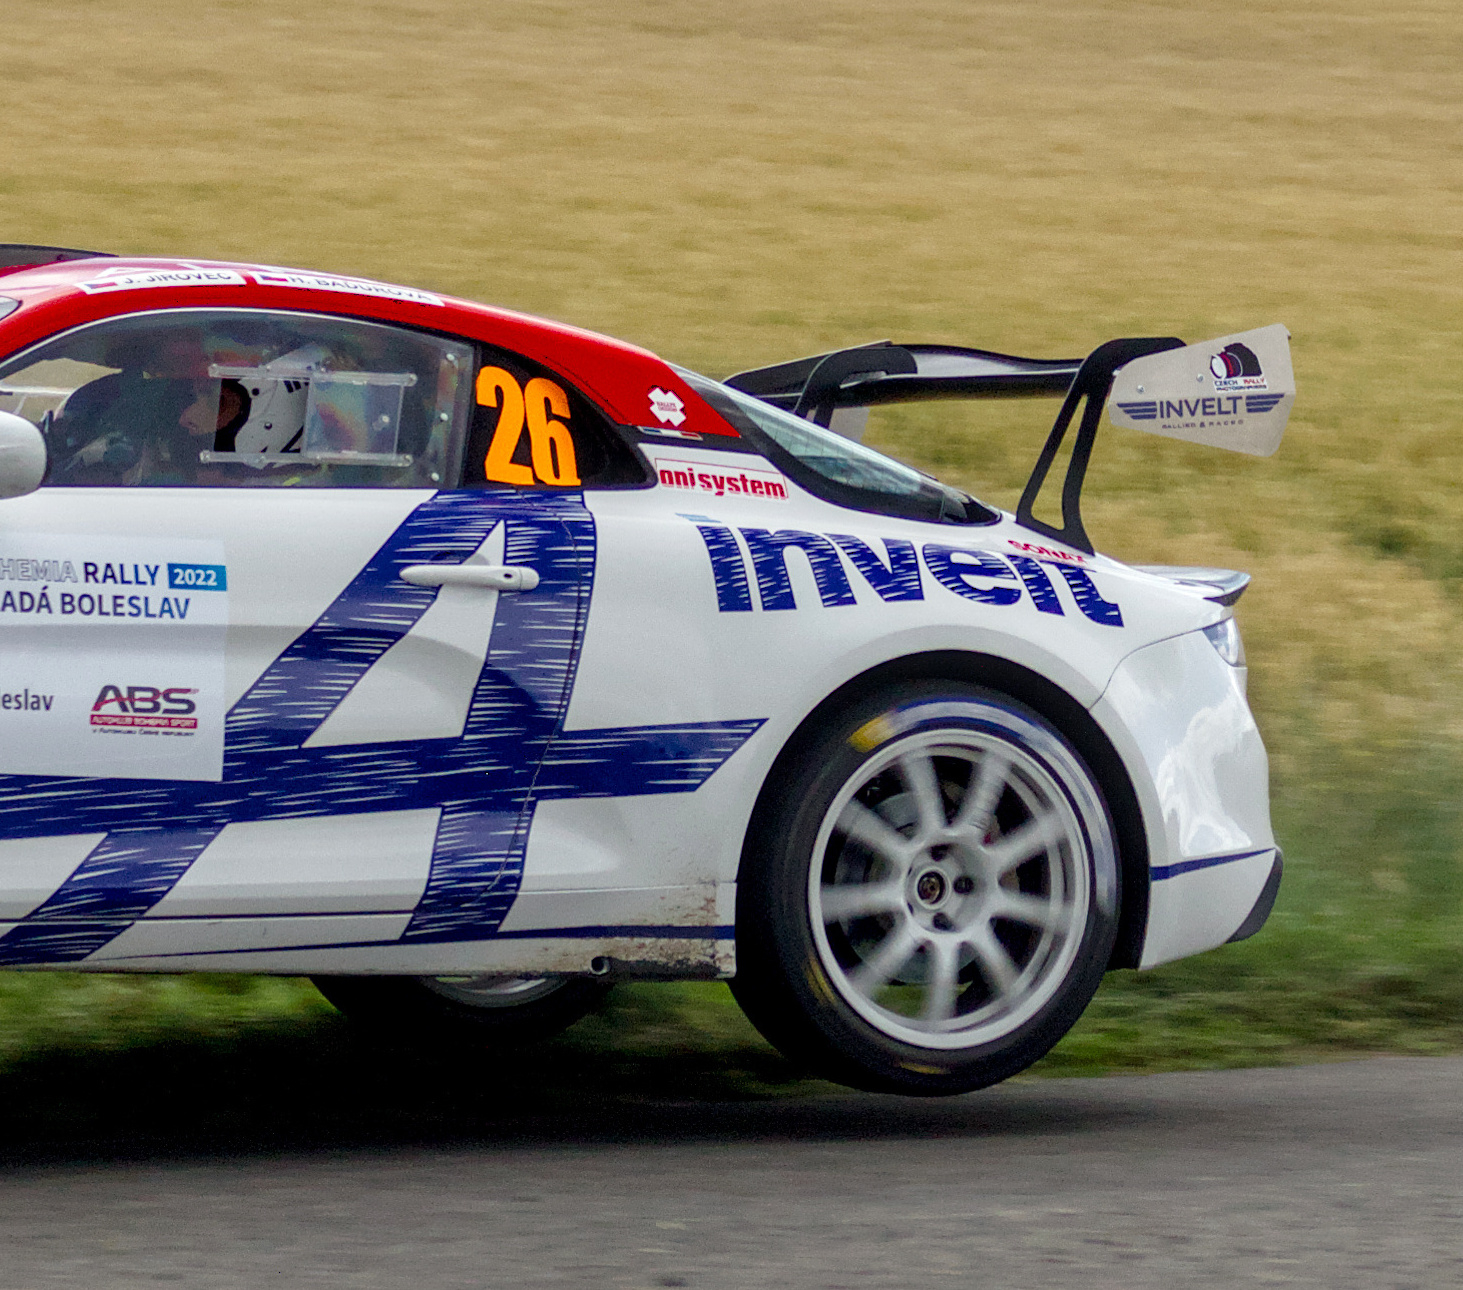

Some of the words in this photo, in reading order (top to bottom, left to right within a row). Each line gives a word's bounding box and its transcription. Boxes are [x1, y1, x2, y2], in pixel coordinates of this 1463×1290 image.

[146, 271, 232, 283] JIROVEC
[1159, 395, 1243, 419] INVELT
[475, 366, 582, 487] 26
[84, 562, 161, 587] RALLY
[174, 568, 219, 588] 2022
[696, 525, 1124, 628] invelt
[61, 593, 190, 620] BOLESLAV
[91, 685, 199, 715] ABS
